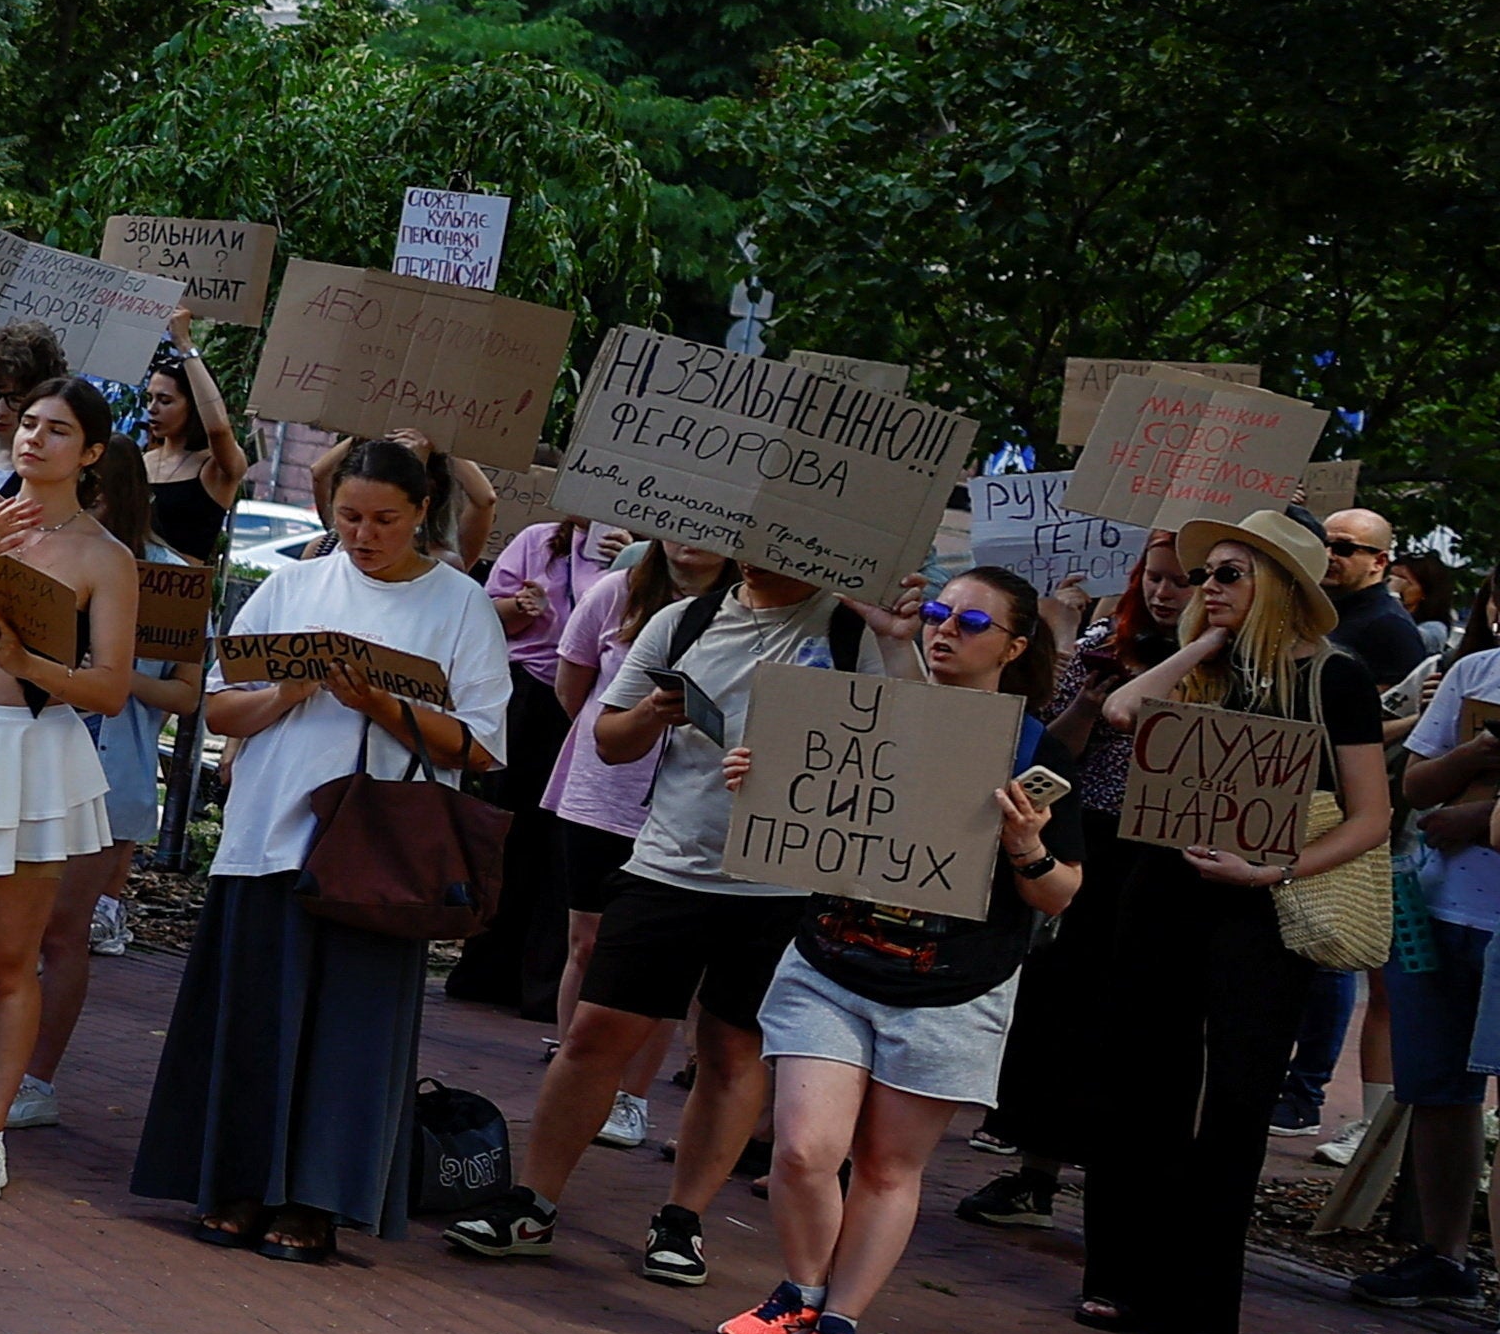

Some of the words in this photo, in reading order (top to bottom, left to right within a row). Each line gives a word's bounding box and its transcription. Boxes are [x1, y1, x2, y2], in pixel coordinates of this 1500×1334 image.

[407, 190, 468, 209] СЮЖЕТ
[427, 211, 490, 228] КУЛЬГАЄ
[124, 217, 246, 251] ЗВІЛЬНИЛИ
[402, 226, 480, 247] ПЕРСОНАЖІ
[444, 247, 473, 261] ТЕЖ
[8, 240, 30, 260] НЕ
[29, 250, 116, 284] ВИХОДИМО
[158, 248, 190, 269] ЗА
[68, 280, 96, 304] МИ
[92, 287, 175, 320] ВИМАГАЄМО
[303, 286, 382, 330] АБО
[276, 357, 340, 392] НЕ
[604, 332, 664, 398] НІ
[1138, 397, 1283, 429] МАЛЕНЬКИЙ
[611, 401, 849, 499] ФЕДОРОВА
[1145, 421, 1250, 453] СОВОК
[1109, 442, 1148, 468] НЕ
[1153, 451, 1299, 500] ПЕРЕМОЖЕ
[1034, 521, 1121, 555] ГЕТЬ
[222, 633, 372, 664] ВИКОНУЙ
[840, 680, 883, 733] У
[805, 730, 897, 781] ВАС
[1134, 710, 1319, 796] СЛУХАЙ
[789, 773, 895, 826] СИР
[1131, 784, 1300, 865] НАРОД
[743, 814, 957, 890] ПРОТУХ
